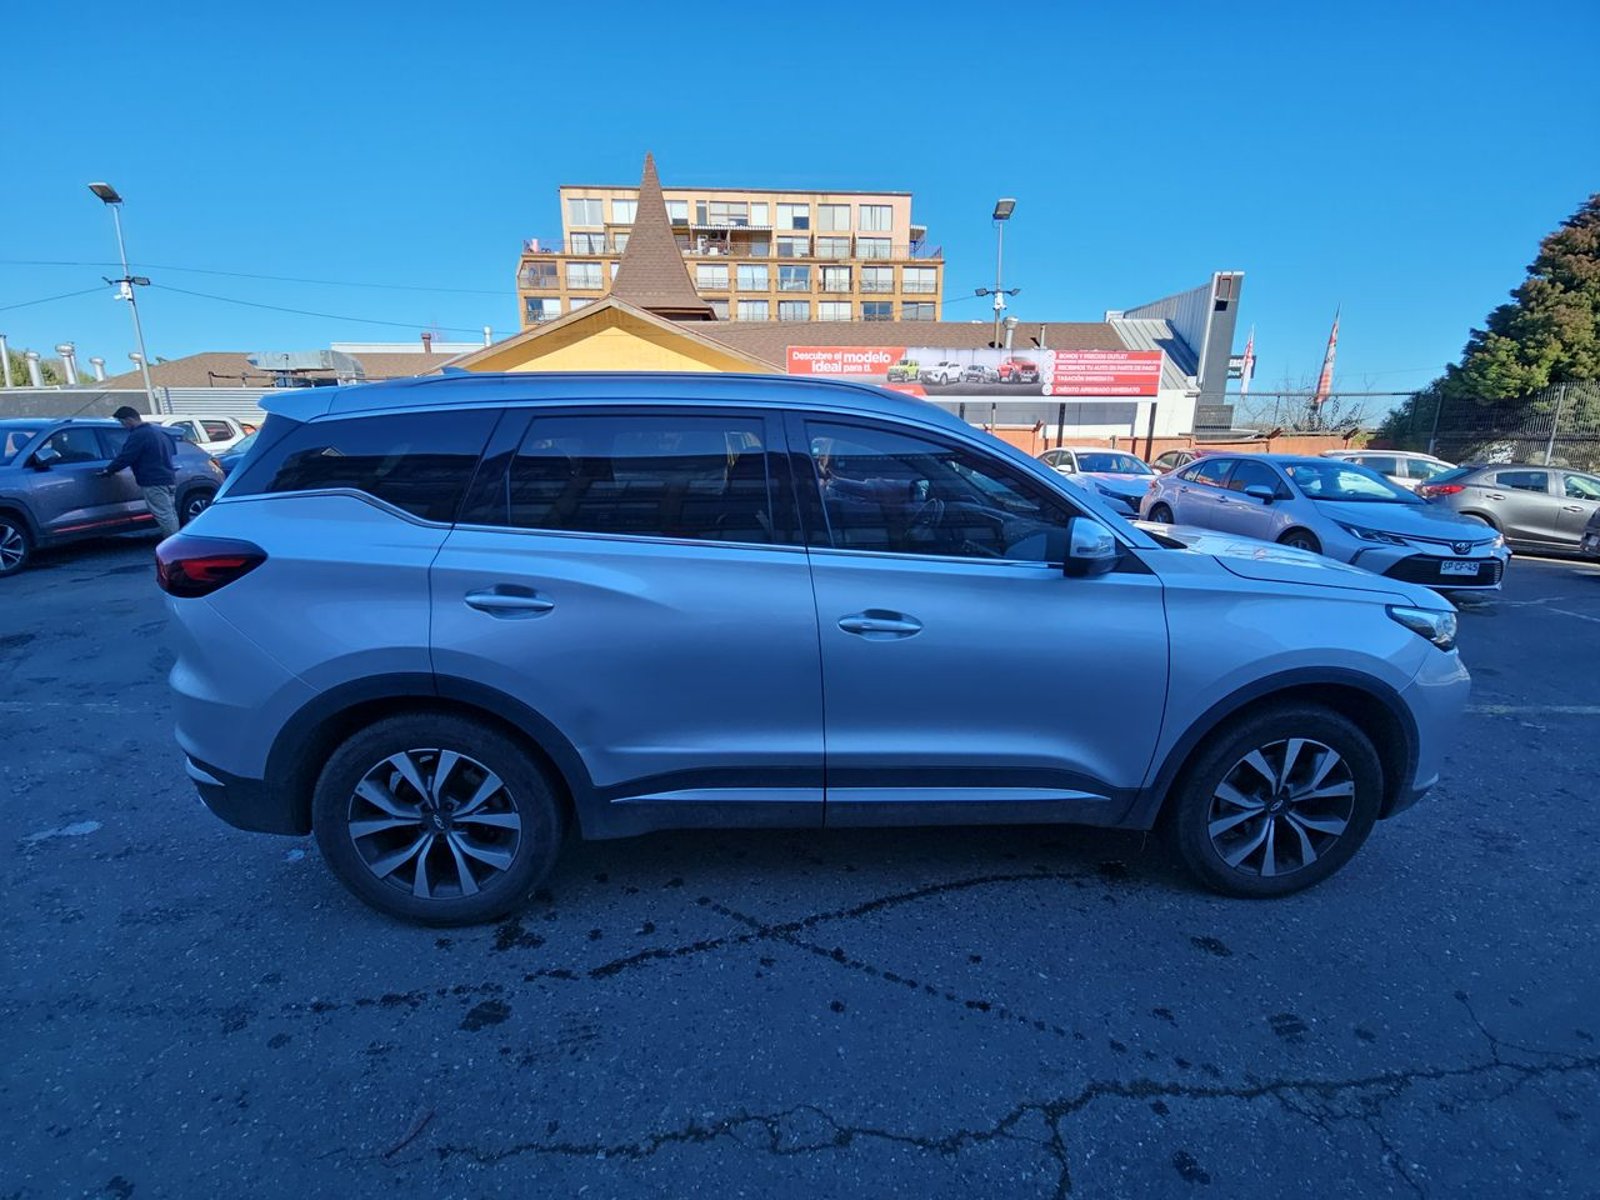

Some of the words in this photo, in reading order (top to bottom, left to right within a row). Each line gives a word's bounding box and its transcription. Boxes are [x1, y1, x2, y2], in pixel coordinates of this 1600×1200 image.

[792, 351, 833, 360] Descubre
[834, 351, 842, 360] el
[843, 351, 891, 363] modelo
[812, 361, 842, 372] ideal
[843, 363, 862, 373] para
